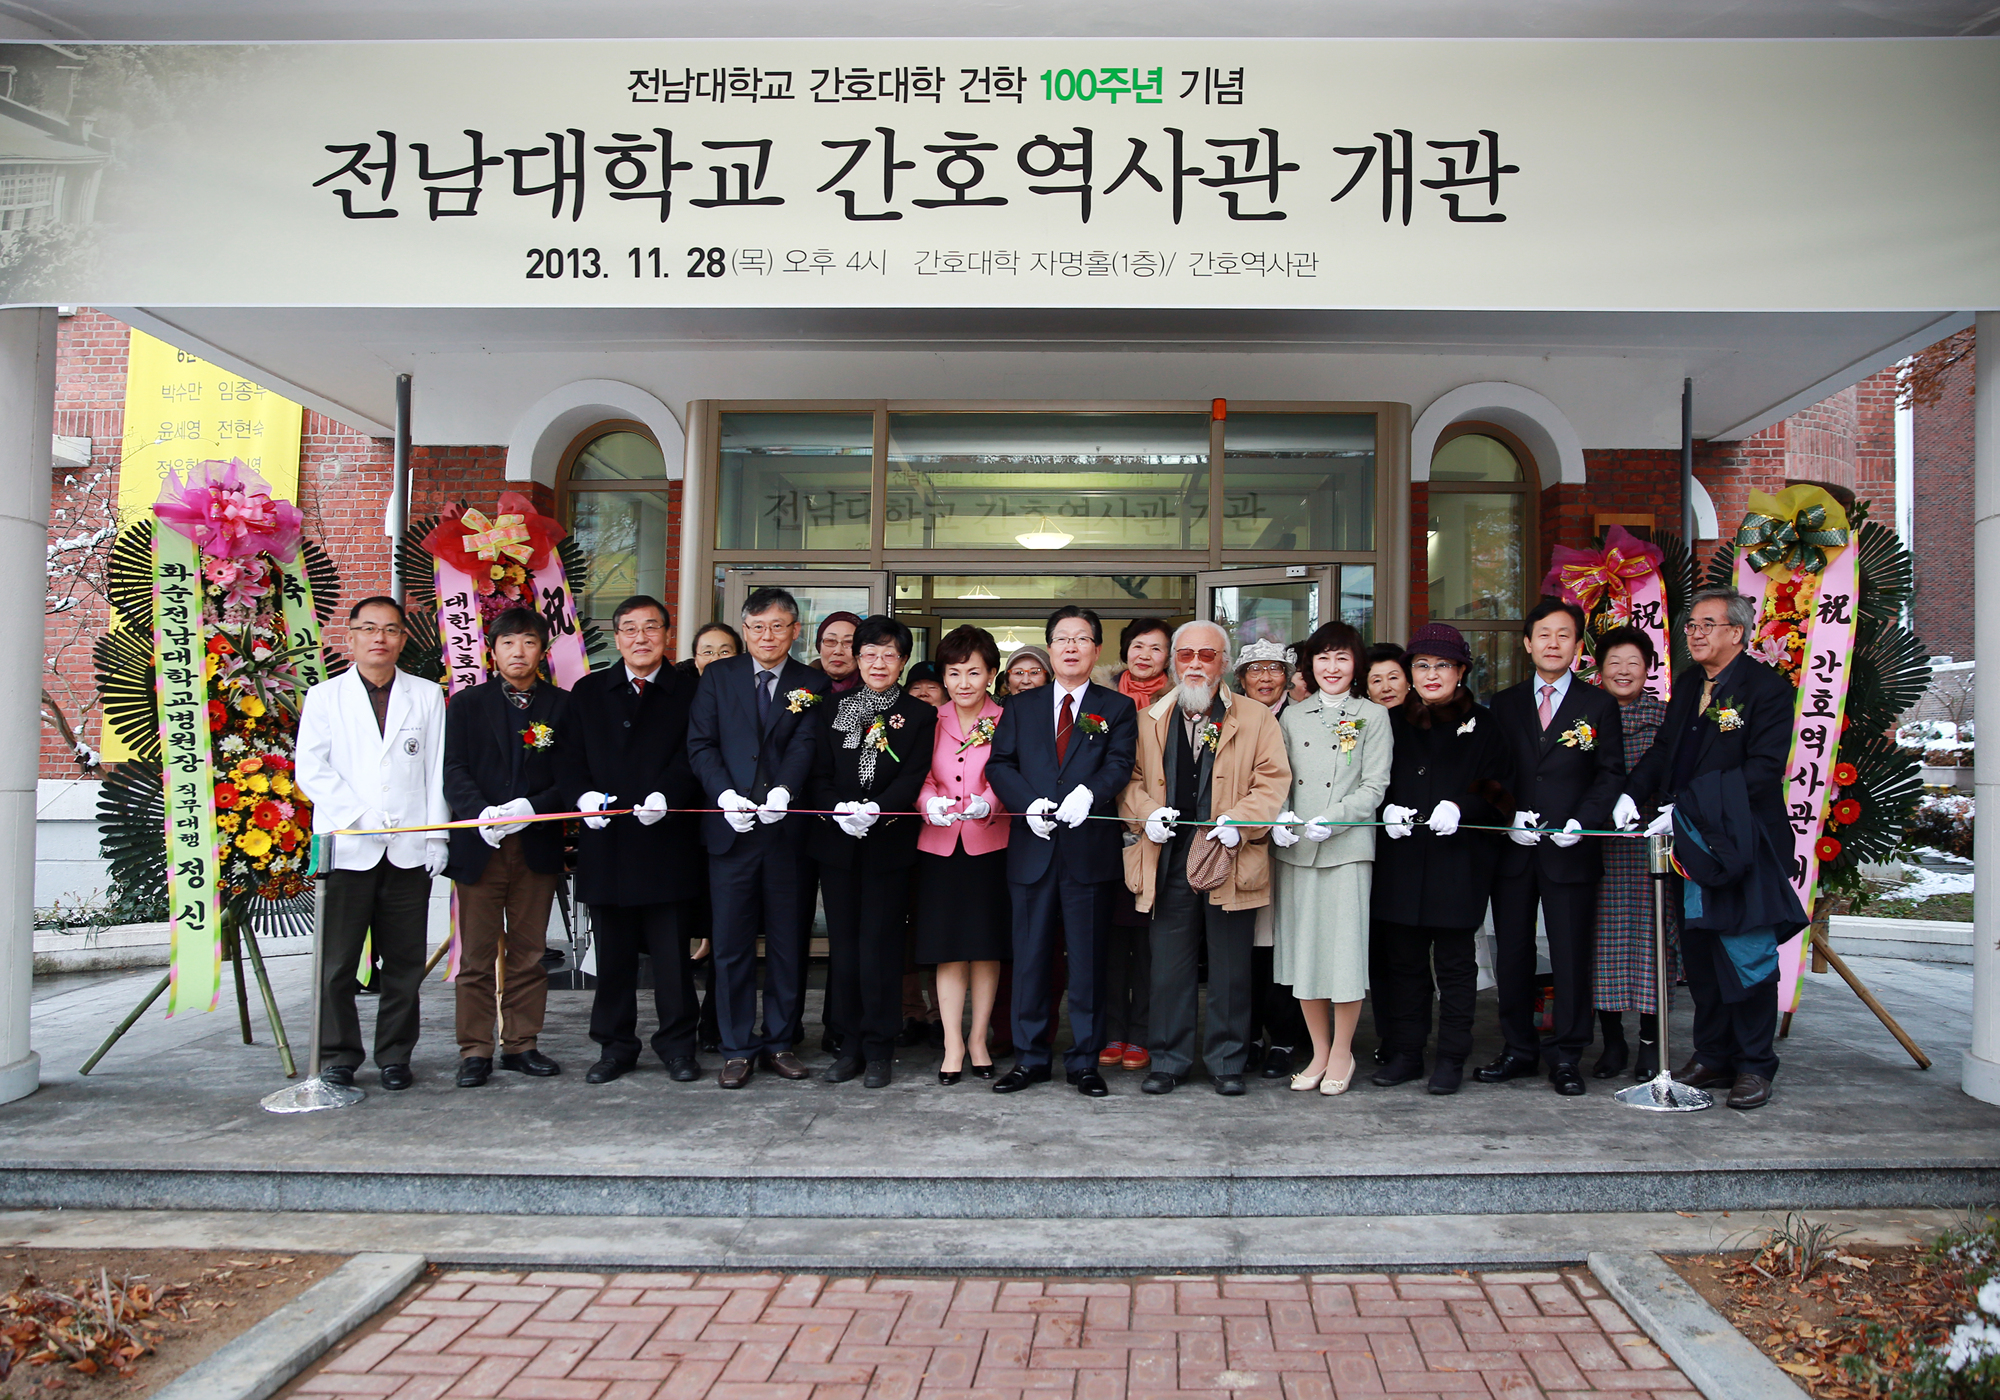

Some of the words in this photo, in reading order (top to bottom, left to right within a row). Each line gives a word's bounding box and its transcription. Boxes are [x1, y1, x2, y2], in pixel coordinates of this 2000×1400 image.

[628, 67, 795, 103] 전남대학교
[810, 67, 945, 103] 간호대학
[959, 66, 1027, 103] 건학
[1041, 67, 1163, 104] 100주년
[1180, 67, 1244, 104] 기념
[312, 128, 785, 223] 전남대학교
[817, 127, 1300, 225] 간호역사관
[1331, 129, 1520, 226] 개관
[526, 247, 608, 278] 2013.
[629, 247, 668, 278] 11.
[783, 249, 836, 275] 오후
[846, 250, 885, 275] 4시
[915, 250, 1020, 275] 간호대학
[1189, 252, 1319, 277] 간호역사관
[161, 381, 202, 403] 박수만
[157, 420, 201, 441] 윤세영
[217, 420, 264, 440] 전현숙
[284, 574, 306, 607] 축
[543, 586, 575, 637] 祝
[1630, 600, 1665, 630] 祝
[1816, 594, 1851, 624] 祝
[160, 563, 204, 773] 화순전남대학교병원장
[174, 783, 202, 848] 직무대행
